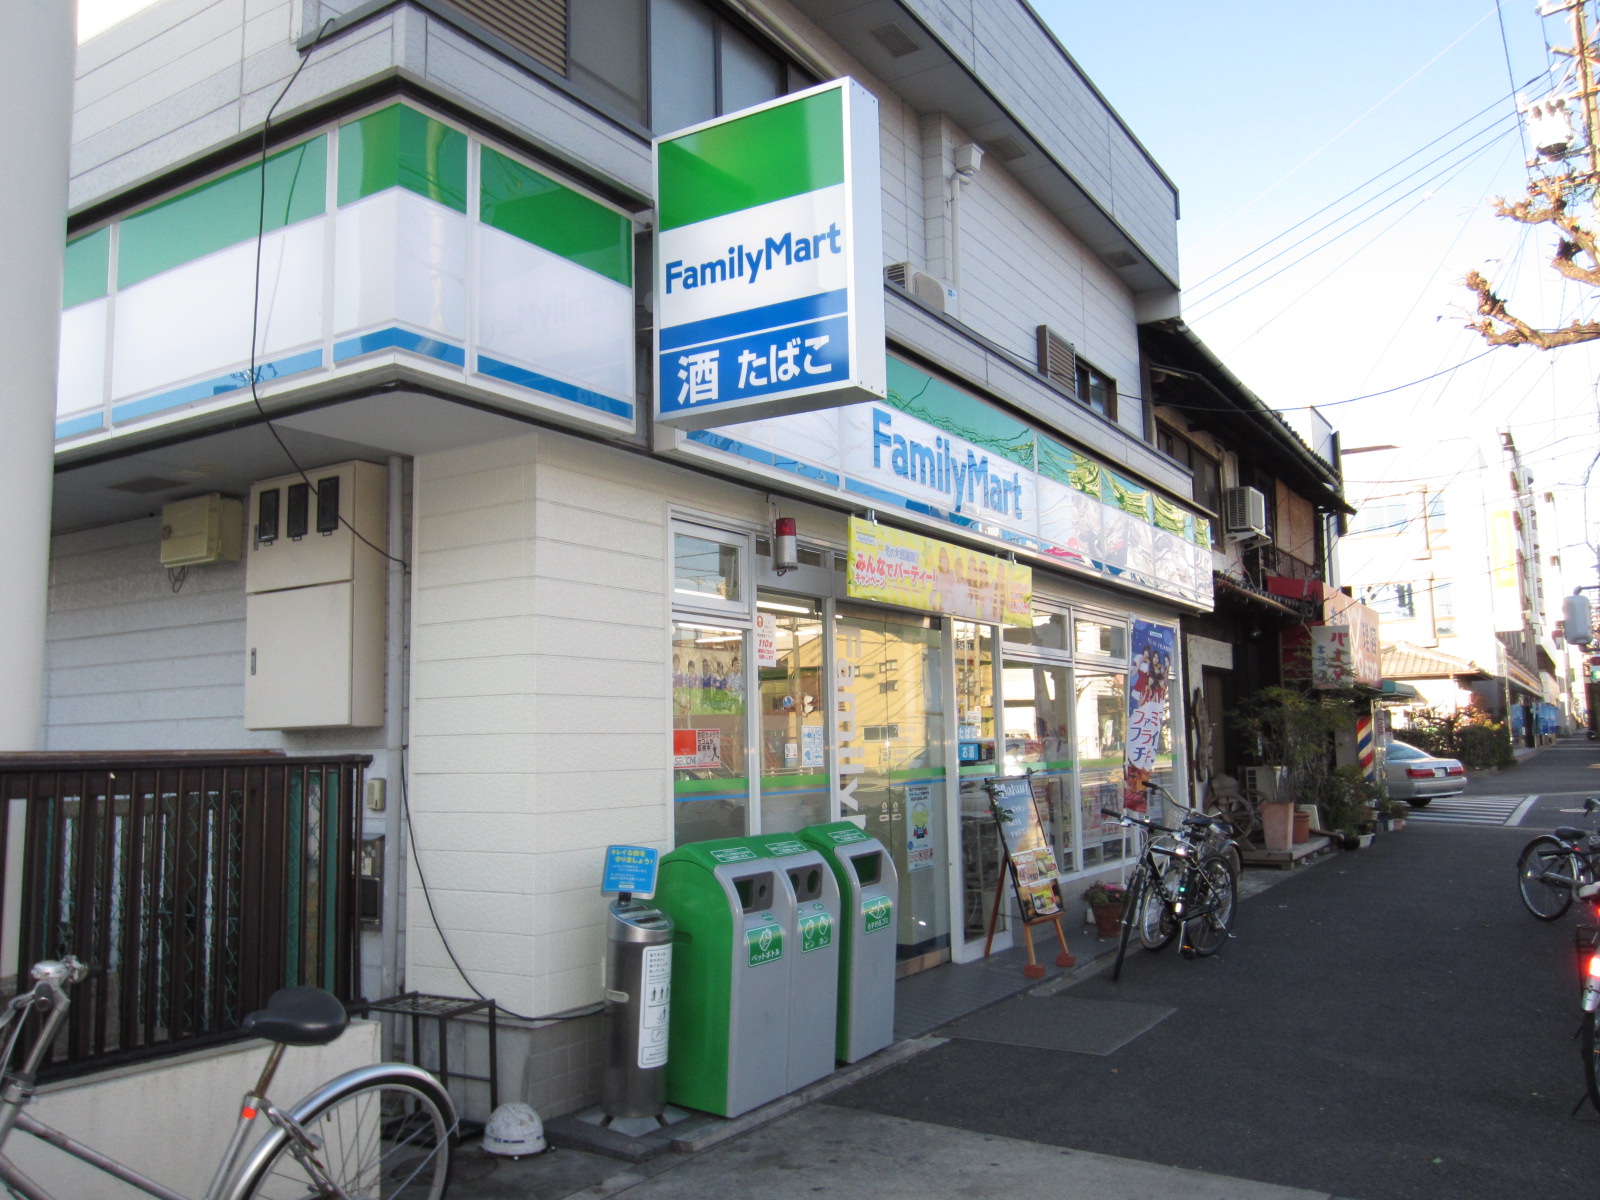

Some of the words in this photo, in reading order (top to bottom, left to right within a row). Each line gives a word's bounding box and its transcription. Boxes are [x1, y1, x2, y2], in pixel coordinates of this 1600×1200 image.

[665, 222, 841, 294] FamilyMart
[677, 349, 719, 406] 酒
[737, 334, 832, 390] たばこ
[872, 406, 1022, 521] FamilyMart
[855, 573, 886, 587] キャンペーン
[958, 726, 977, 739] たばこ
[751, 948, 780, 962] ペットボトル
